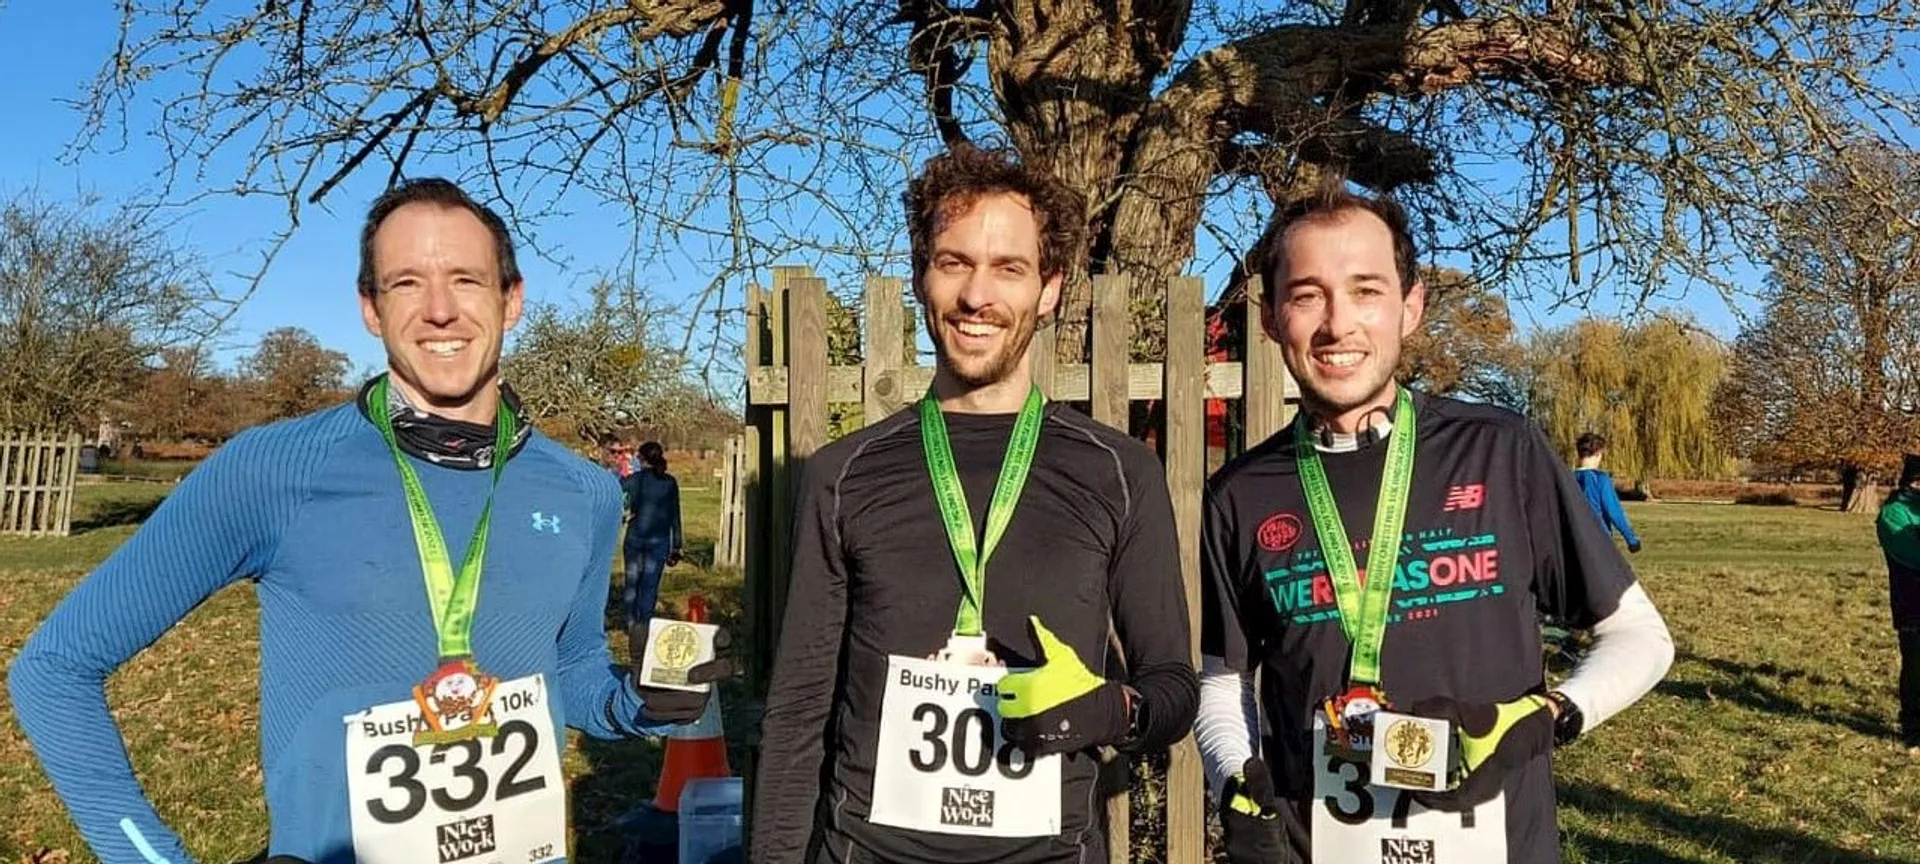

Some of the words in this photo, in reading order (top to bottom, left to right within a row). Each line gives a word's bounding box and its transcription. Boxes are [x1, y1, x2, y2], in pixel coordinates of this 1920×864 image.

[1336, 562, 1351, 587] 2021
[900, 668, 959, 695] Bushy
[500, 690, 534, 712] 10k
[365, 720, 547, 825] 332
[948, 789, 989, 808] Nice
[942, 805, 993, 827] Work
[443, 816, 490, 844] Nice
[440, 830, 494, 862] Work
[529, 844, 554, 863] 332
[1387, 839, 1431, 858] Nice
